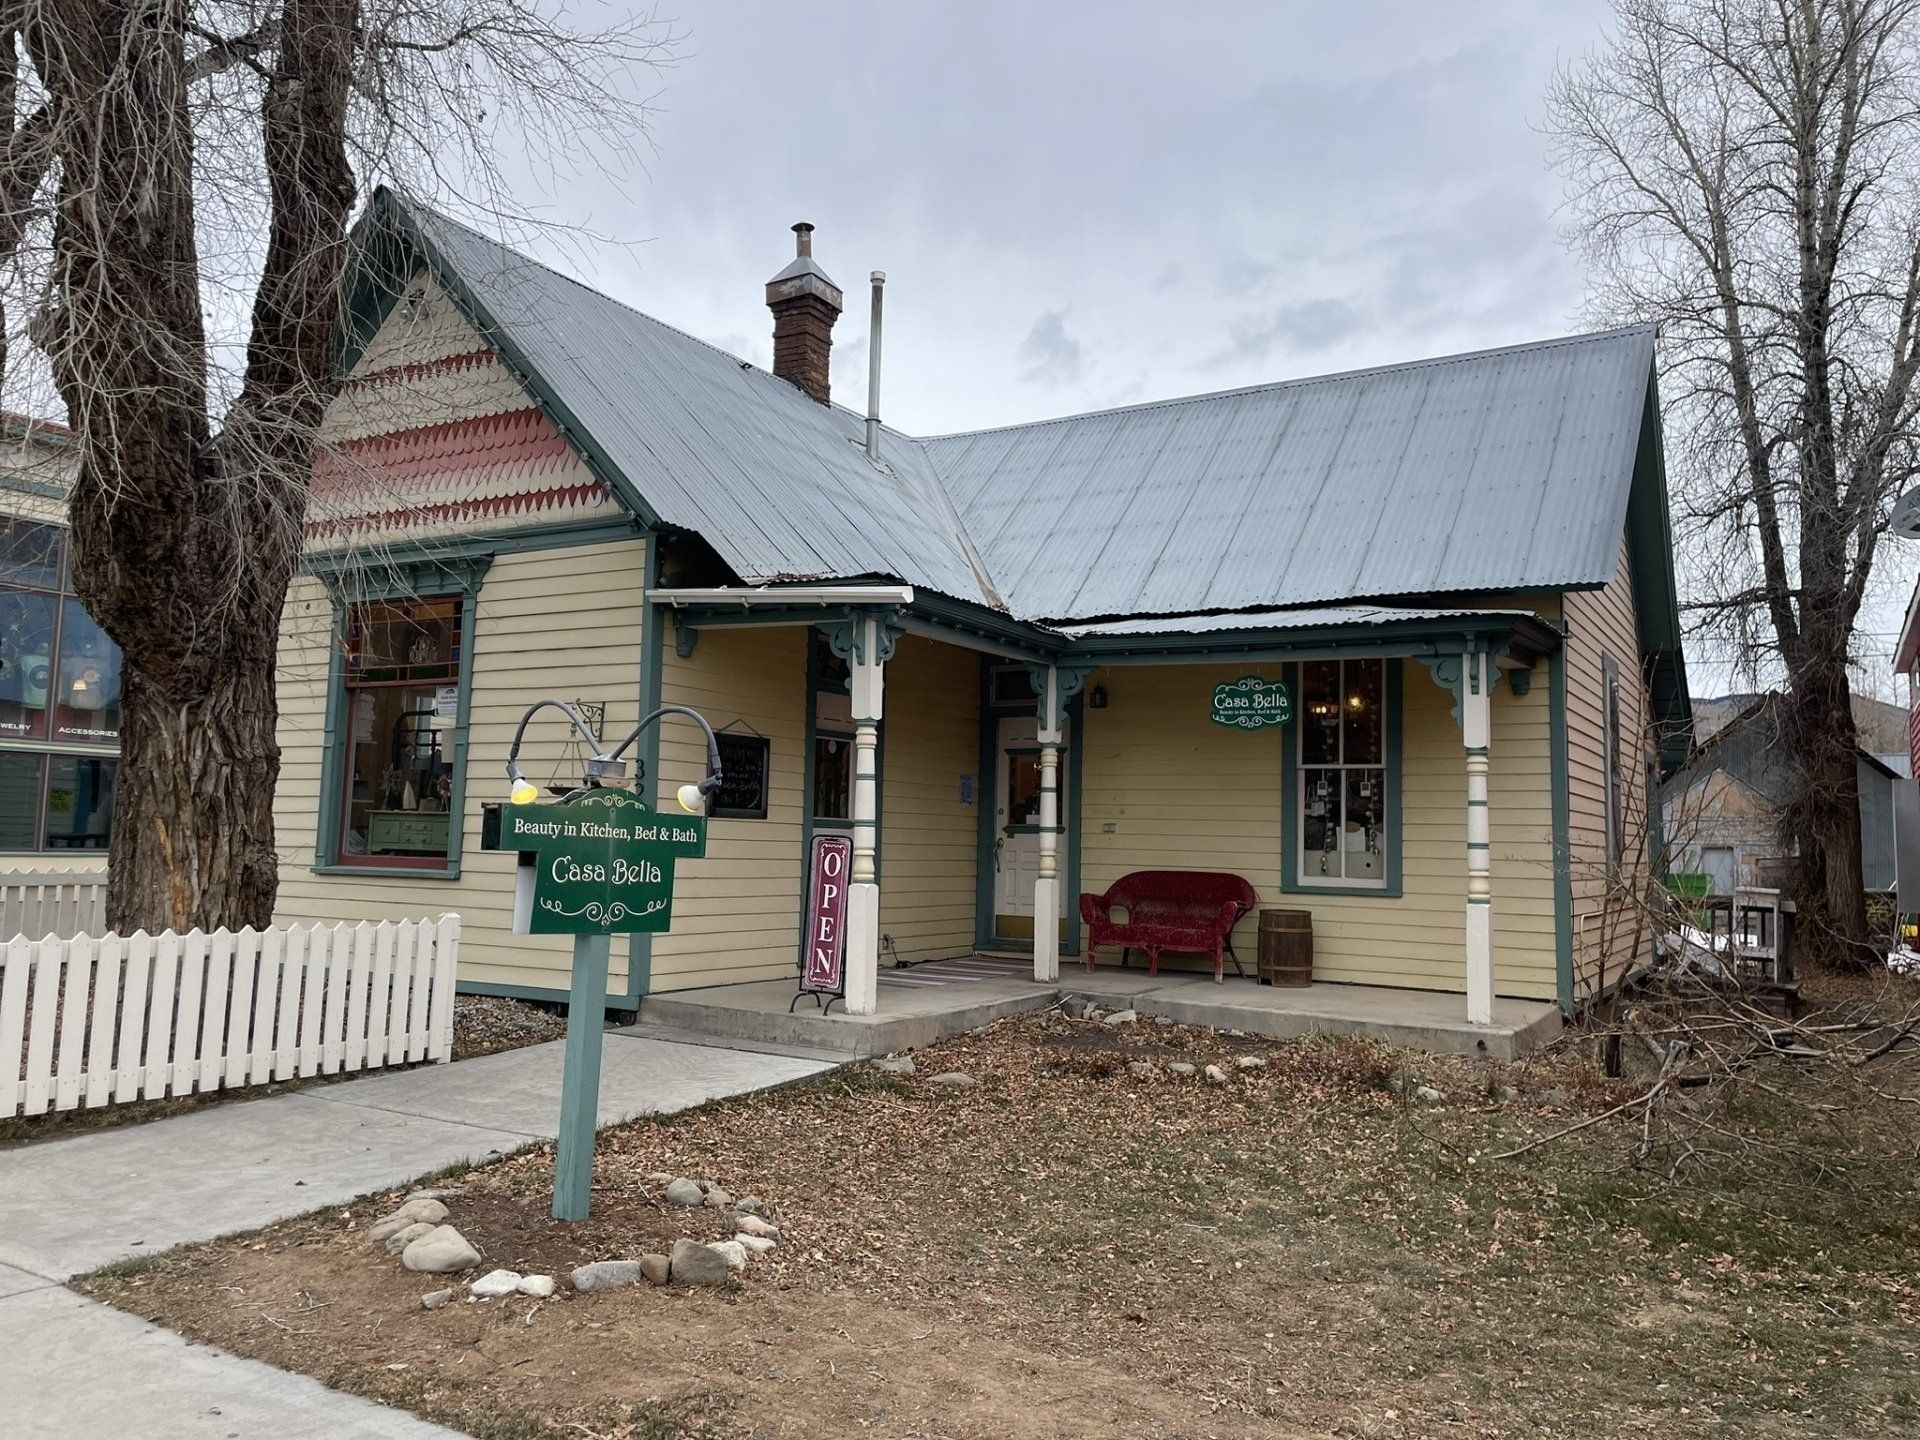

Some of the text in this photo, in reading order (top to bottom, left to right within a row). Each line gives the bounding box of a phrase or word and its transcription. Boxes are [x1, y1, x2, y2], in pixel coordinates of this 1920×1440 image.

[1214, 693, 1288, 709] Casa Bella
[58, 726, 118, 738] ACCESSORIES
[513, 818, 697, 842] Beauty in Kitchen, Bed & Bath
[552, 855, 662, 885] Casa Bella
[815, 852, 842, 974] OPEN
